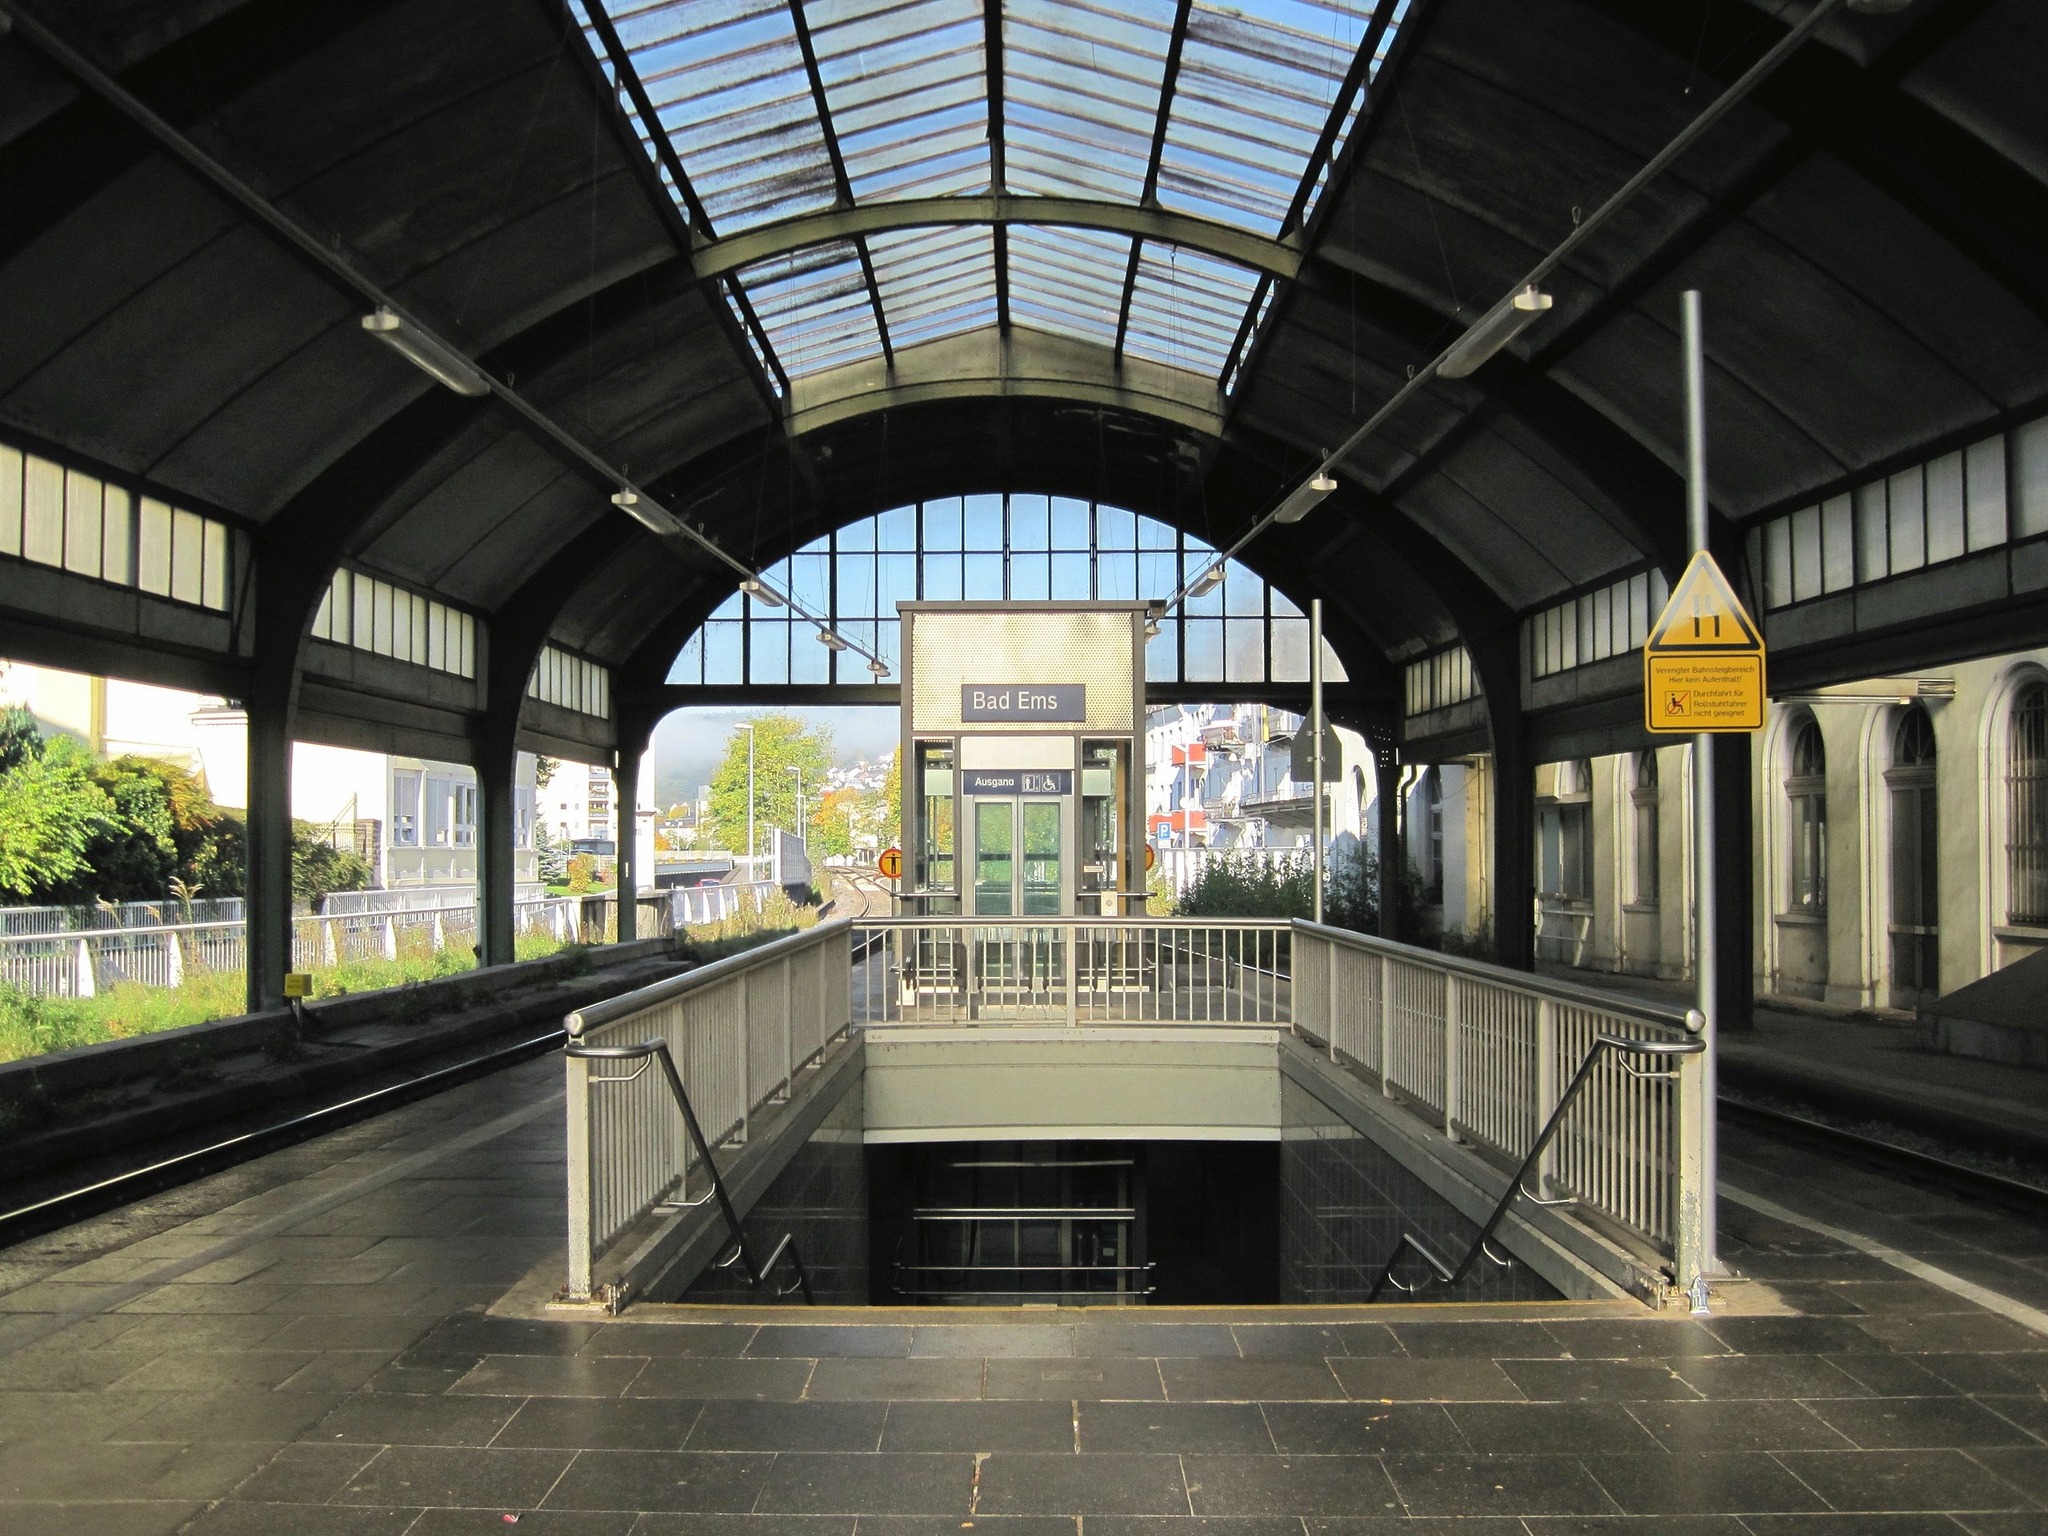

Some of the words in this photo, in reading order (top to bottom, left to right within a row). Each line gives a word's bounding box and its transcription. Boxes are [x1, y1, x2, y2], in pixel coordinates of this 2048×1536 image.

[1655, 667, 1690, 675] Verengter
[1692, 666, 1755, 674] Bahnsteigbereich
[1702, 675, 1742, 683] Aufenthalt!
[973, 691, 1010, 710] Bad
[1018, 691, 1058, 710] Ems
[1693, 700, 1748, 708] Rollstuhlfahrer
[1713, 710, 1745, 718] geeignet
